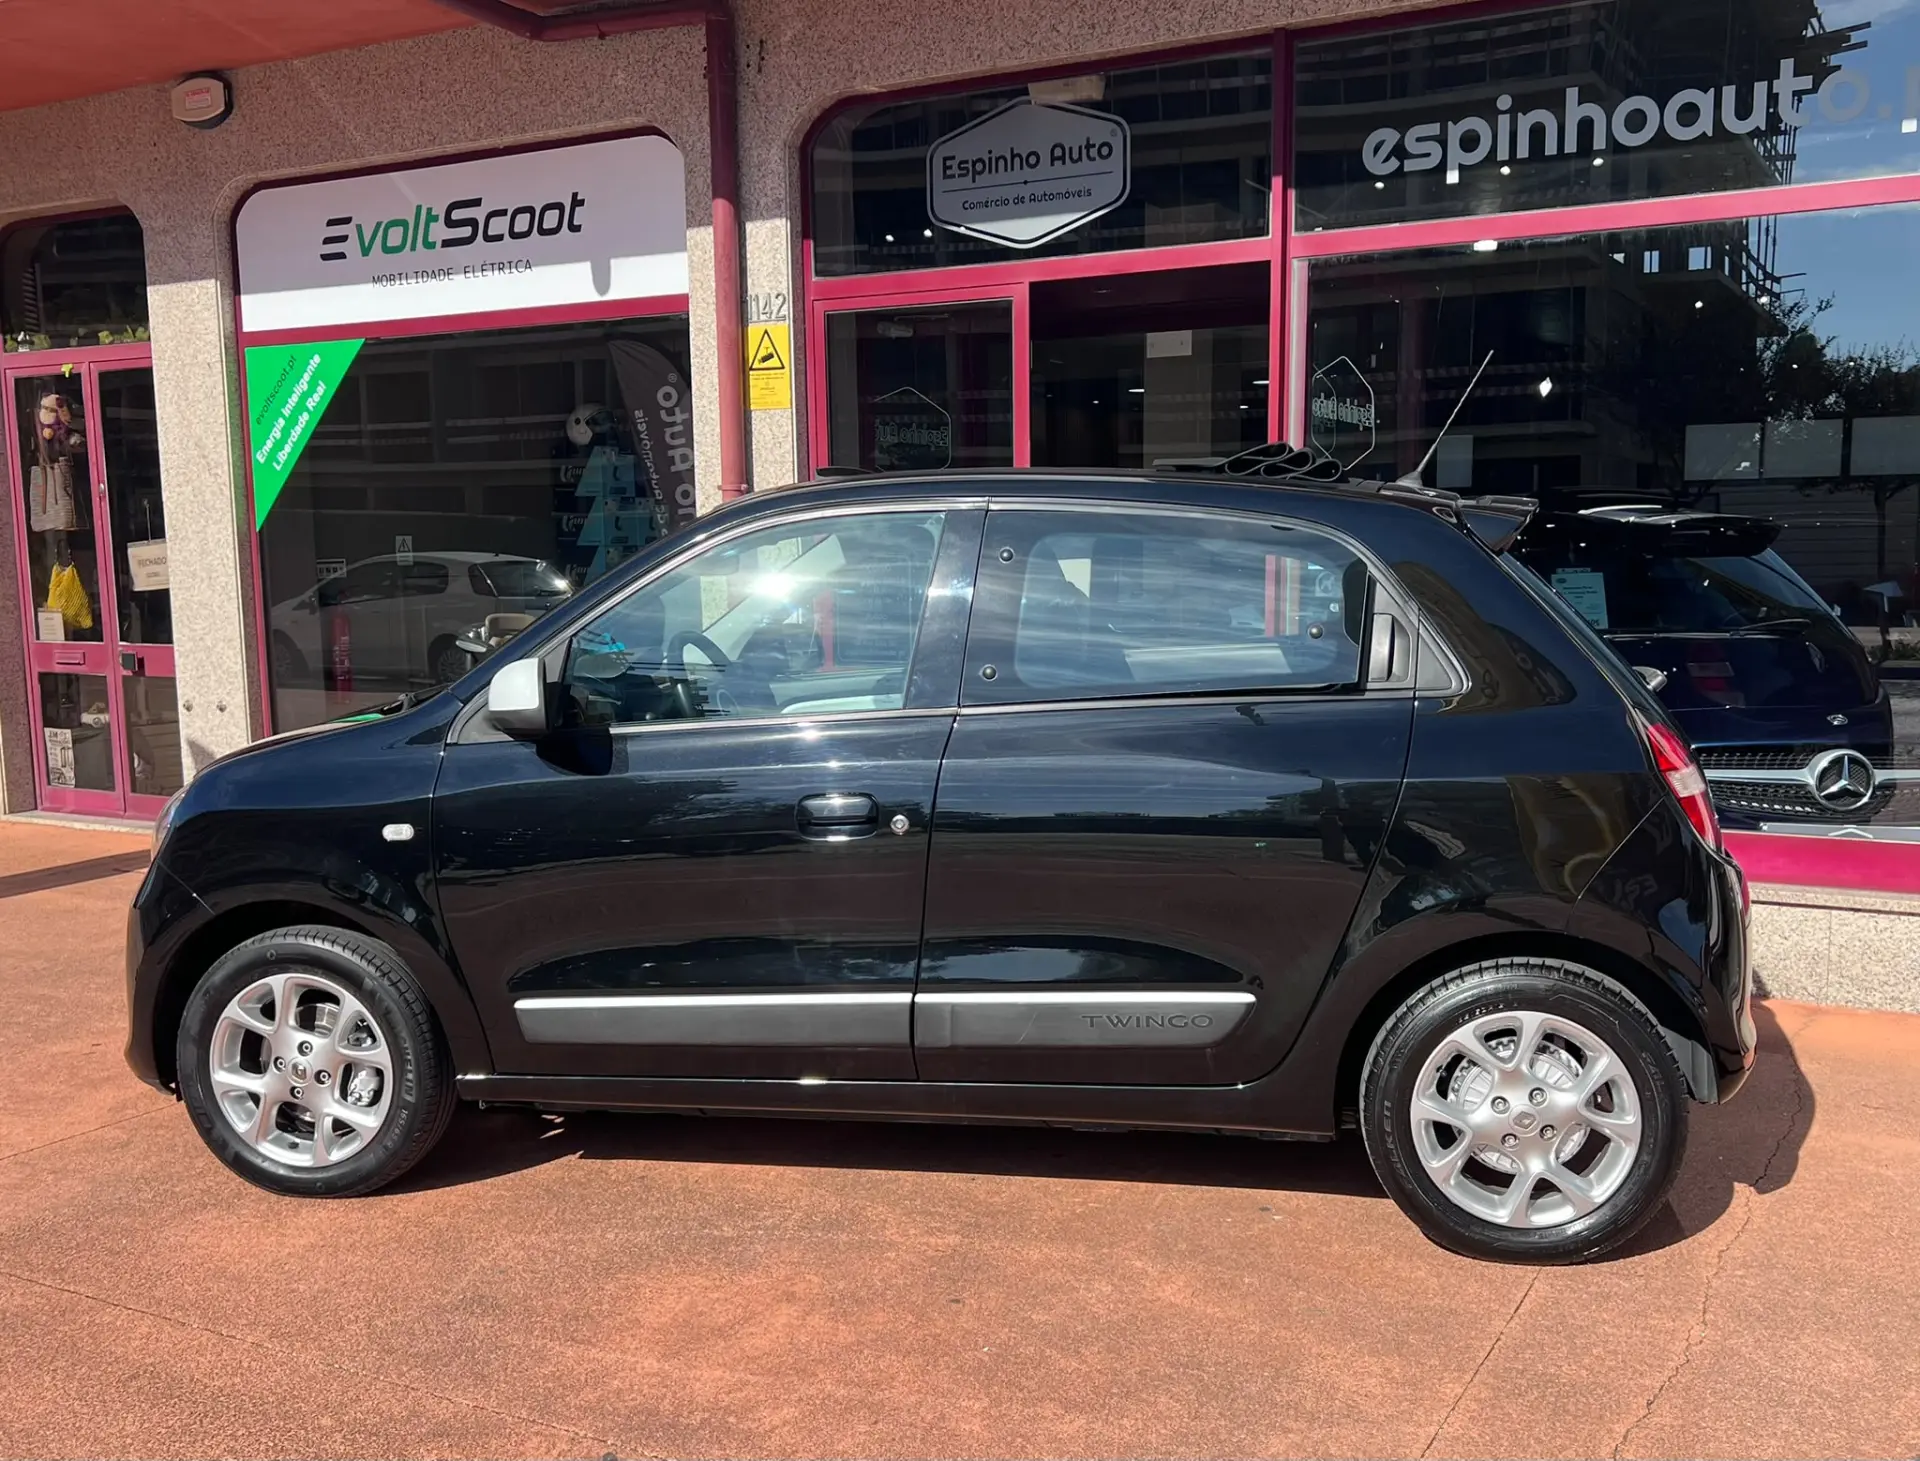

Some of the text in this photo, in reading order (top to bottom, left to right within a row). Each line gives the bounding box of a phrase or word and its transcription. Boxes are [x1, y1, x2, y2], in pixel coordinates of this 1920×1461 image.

[942, 136, 1114, 183] Espinho Auto
[319, 191, 586, 262] EvoltScoot
[962, 185, 1092, 211] Comércio de Automóveis
[371, 258, 534, 288] MOBILIDADE ELÉTRICA
[255, 355, 297, 425] evoltscoot.pt
[256, 353, 321, 464] Energia Inteligente
[272, 379, 327, 471] Liberdade Real
[1081, 1014, 1214, 1029] TWINGO
